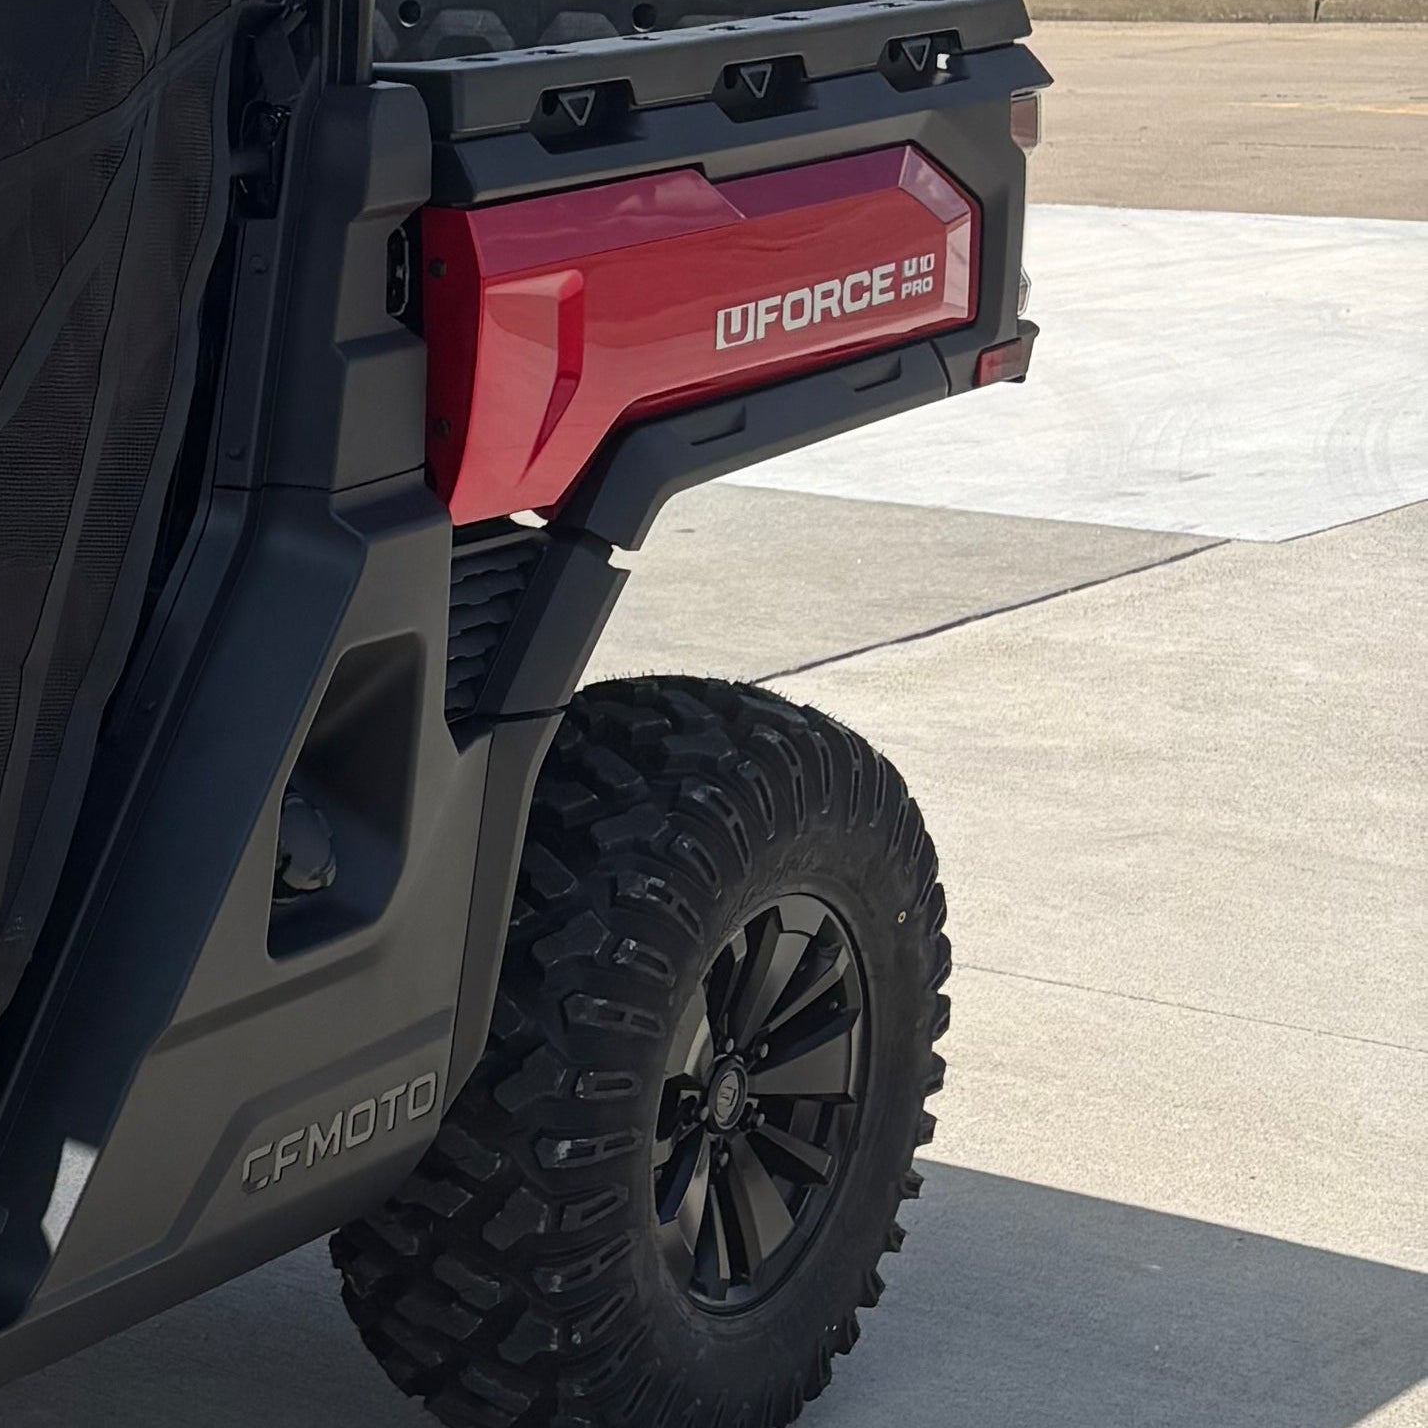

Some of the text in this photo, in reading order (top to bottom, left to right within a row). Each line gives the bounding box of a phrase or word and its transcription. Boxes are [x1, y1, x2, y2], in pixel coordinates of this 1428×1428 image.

[715, 262, 896, 351] UFORCE
[900, 275, 934, 300] PRO
[241, 1071, 438, 1195] CFMOTO
